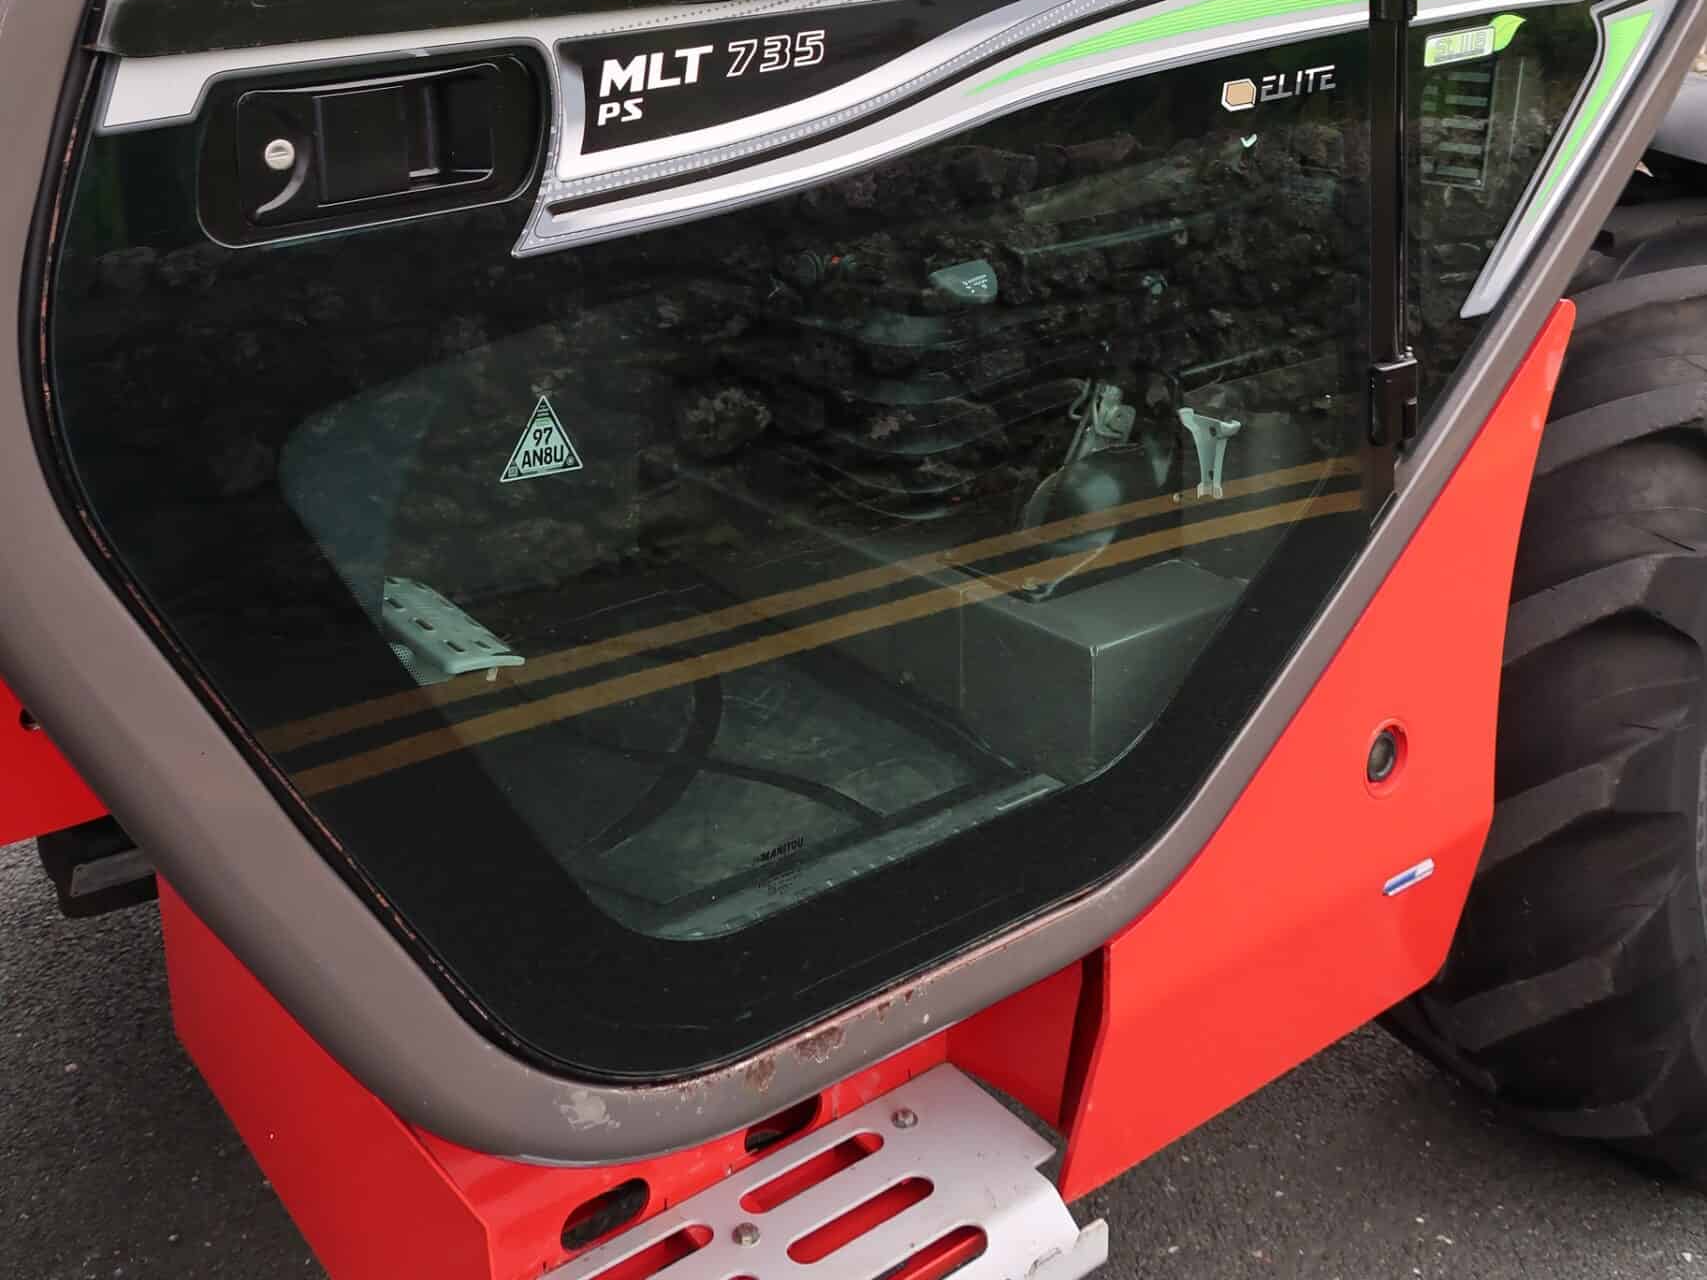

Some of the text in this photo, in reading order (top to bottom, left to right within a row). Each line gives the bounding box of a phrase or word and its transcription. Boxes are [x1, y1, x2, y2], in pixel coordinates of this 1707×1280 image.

[600, 29, 825, 97] MLT 735
[1260, 64, 1336, 102] ELITE
[597, 96, 644, 127] PS
[533, 426, 553, 447] 97
[522, 445, 565, 470] AN8U
